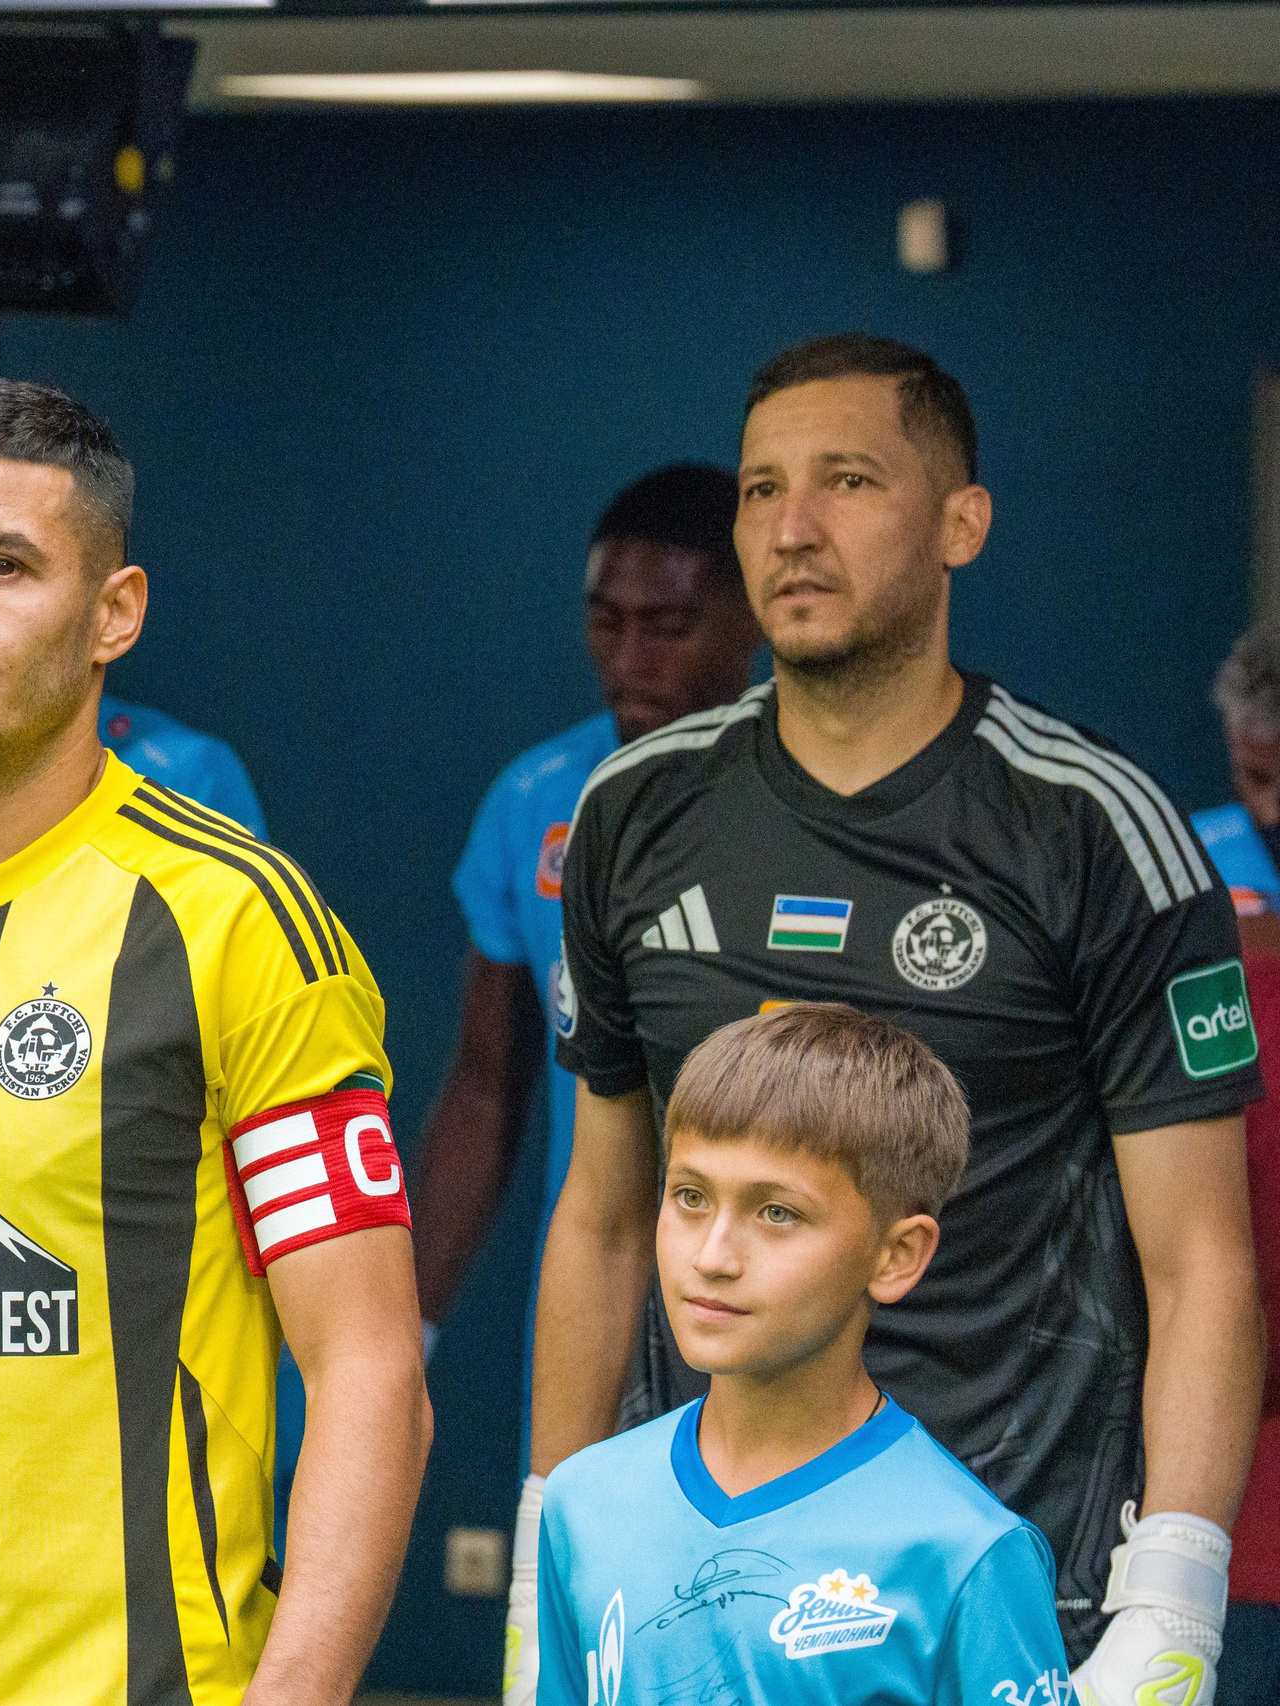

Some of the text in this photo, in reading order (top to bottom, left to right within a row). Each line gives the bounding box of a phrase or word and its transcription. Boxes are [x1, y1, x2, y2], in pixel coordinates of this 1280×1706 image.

[4, 1002, 86, 1036] F.C. NEFTCHI
[1186, 995, 1248, 1041] artel
[24, 1073, 47, 1083] 1962
[46, 1047, 89, 1095] FERGANA
[344, 1113, 401, 1197] C
[794, 1622, 887, 1652] ЧЕМПИОНИКА
